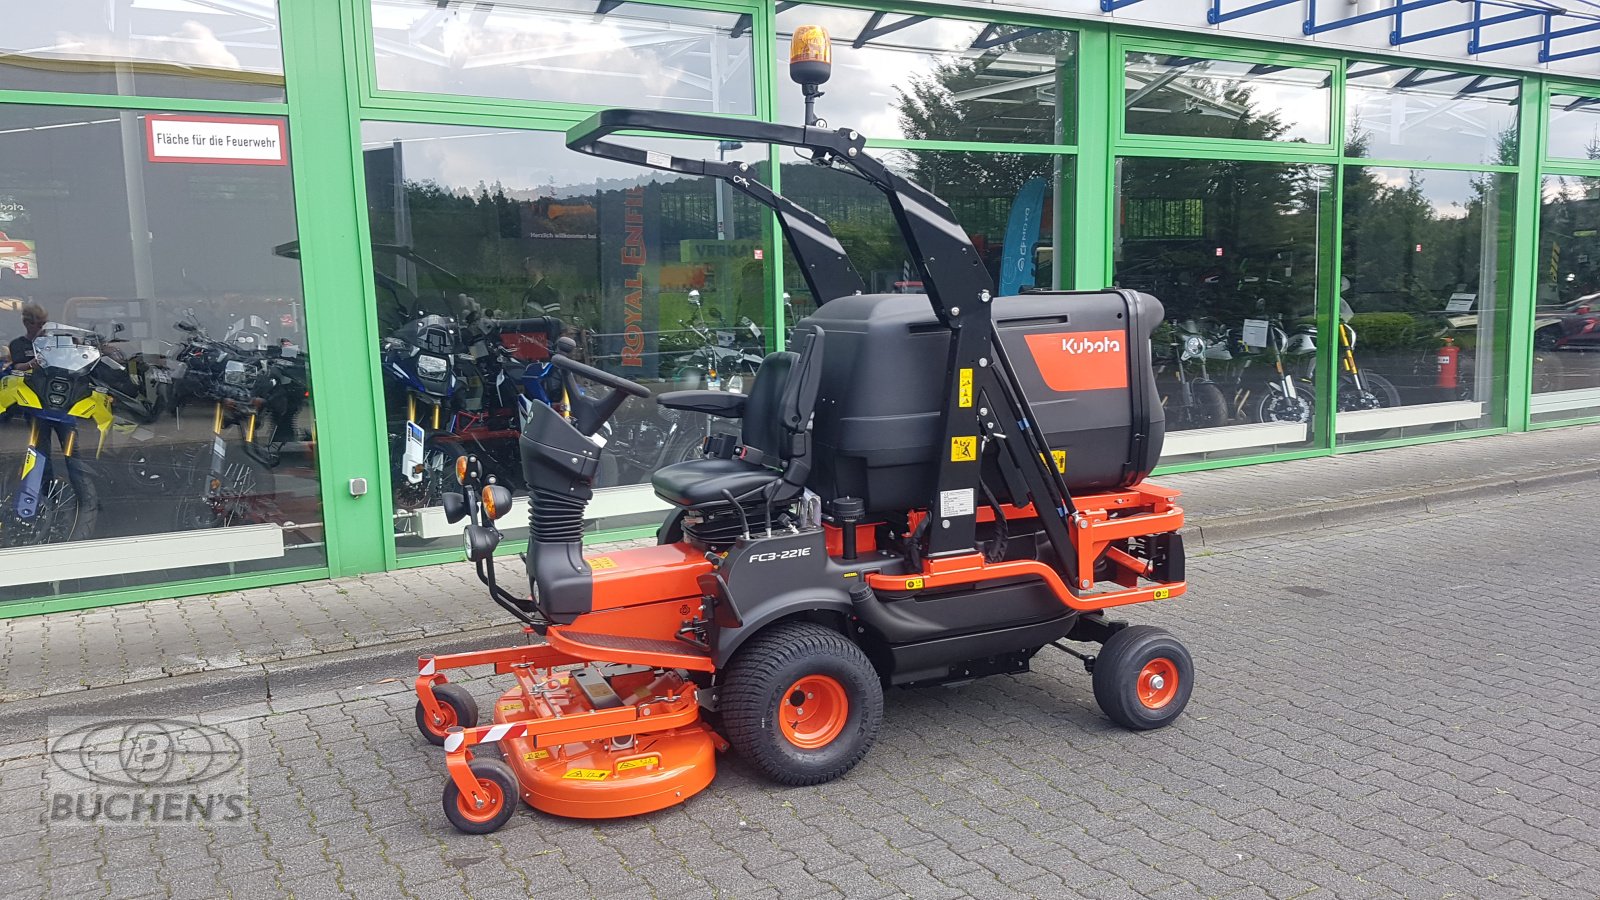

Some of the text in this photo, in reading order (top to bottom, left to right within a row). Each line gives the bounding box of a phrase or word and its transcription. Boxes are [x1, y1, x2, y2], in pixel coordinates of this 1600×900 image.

[156, 132, 277, 149] Fläche für die Feuerwehr
[621, 272, 646, 368] ROYAL
[1062, 336, 1120, 355] Kubota
[749, 546, 812, 564] FC3-221E
